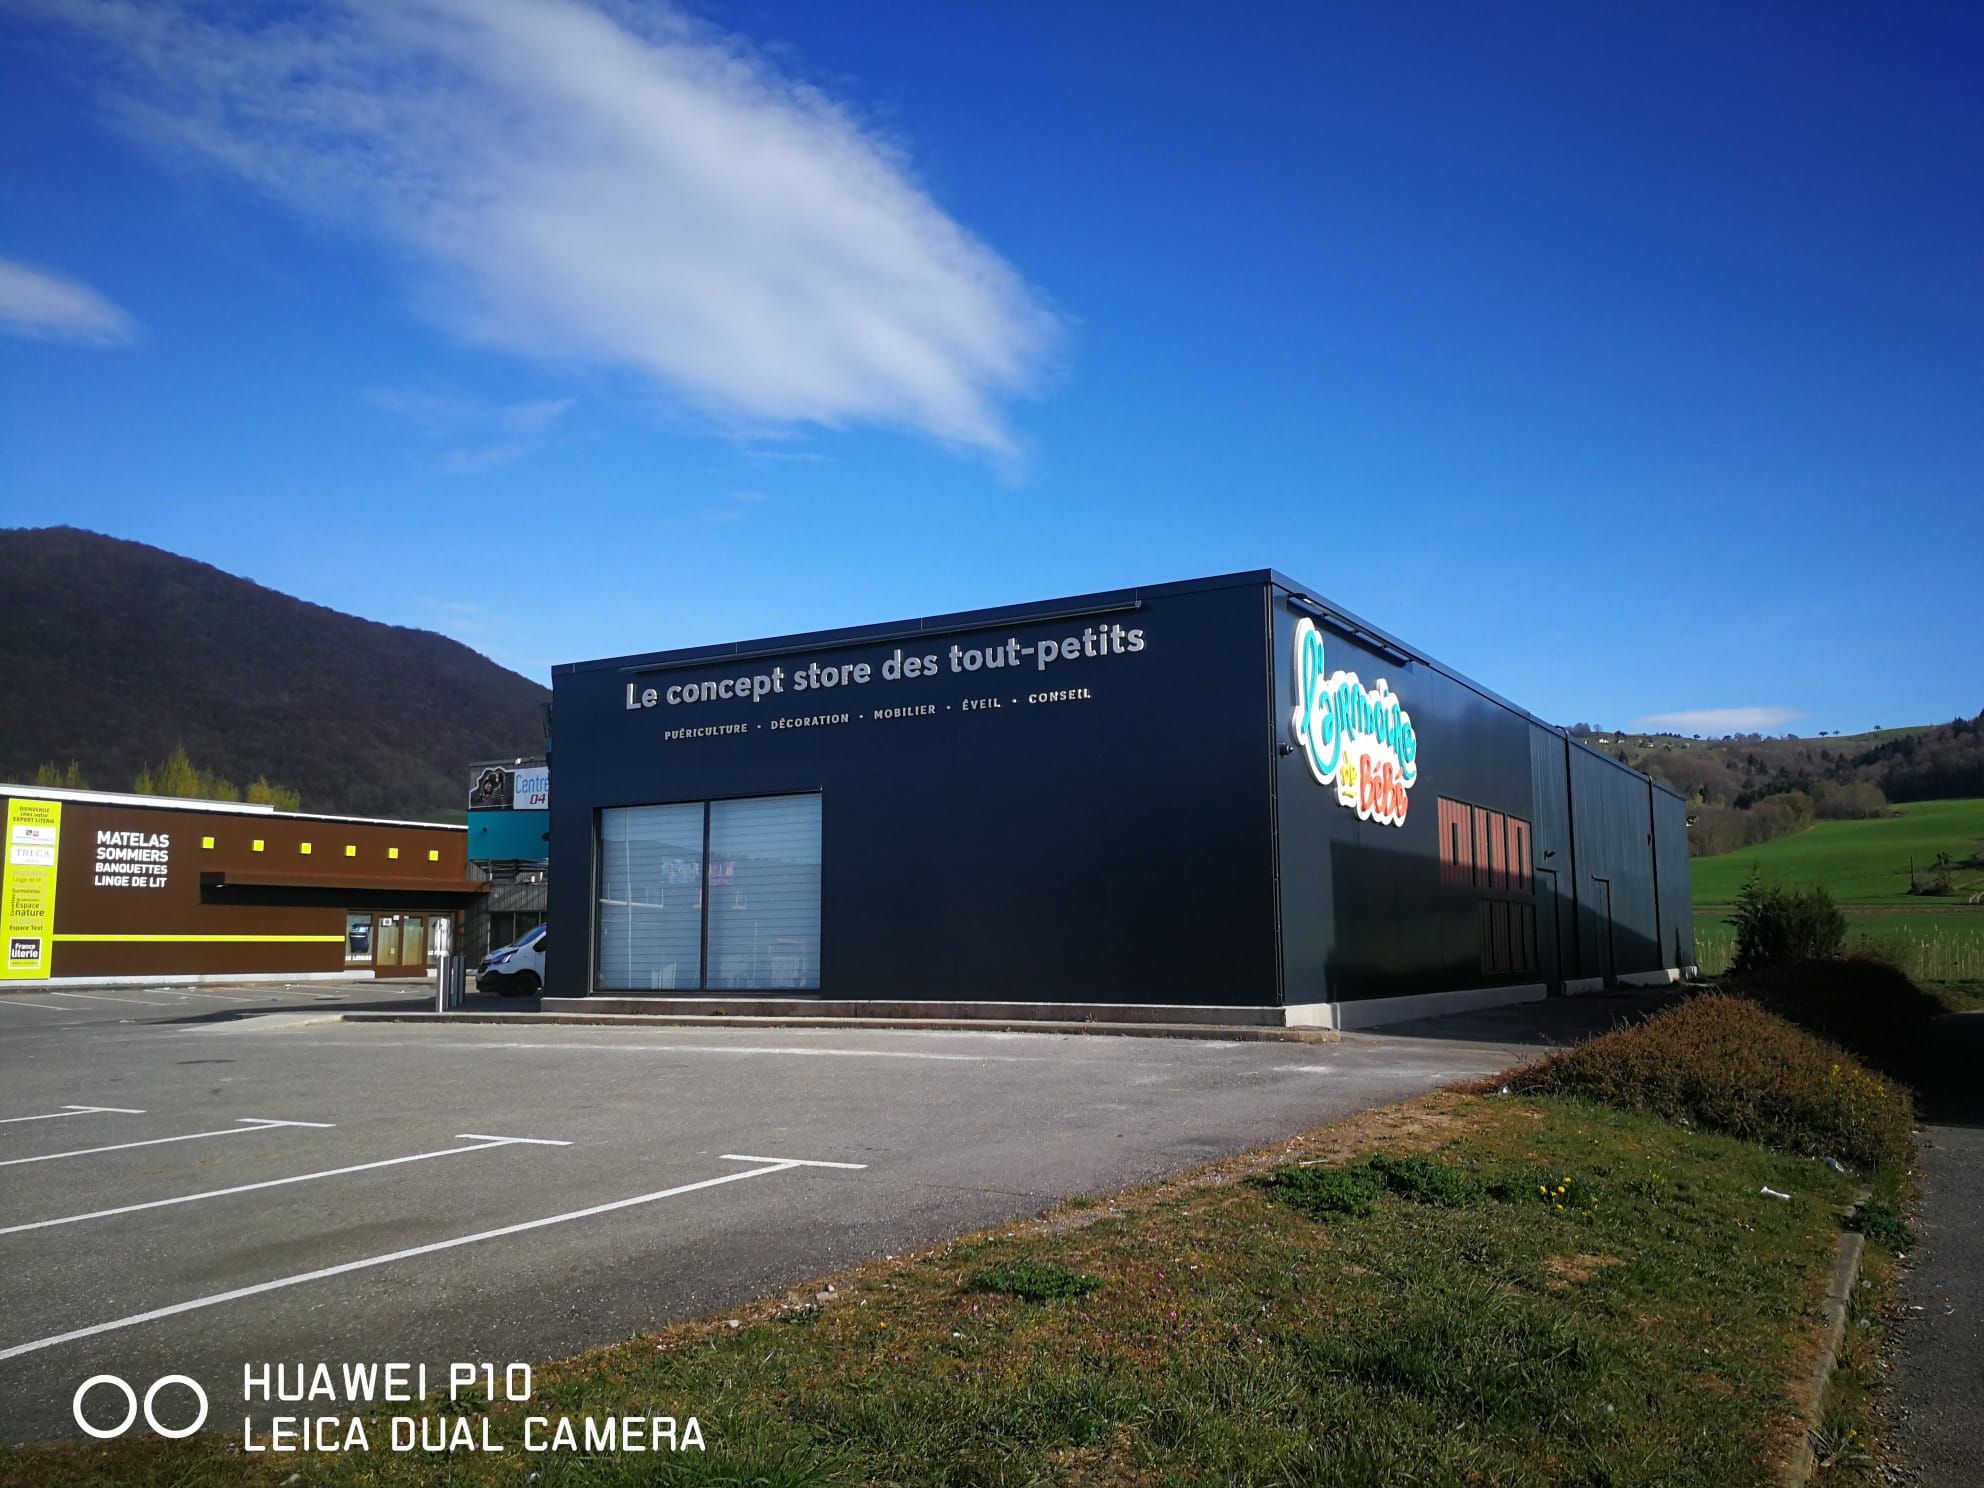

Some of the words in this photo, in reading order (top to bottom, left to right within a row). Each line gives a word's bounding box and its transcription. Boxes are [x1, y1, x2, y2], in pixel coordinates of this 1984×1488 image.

[625, 682, 658, 710] Le
[666, 667, 785, 702] concept
[793, 662, 871, 691] store
[881, 649, 938, 681] des
[949, 623, 1145, 673] tout-petits
[664, 723, 748, 740] PUÉRICULTURE
[770, 713, 849, 730] DÉCORATION
[874, 704, 936, 720] MOBILIER
[962, 698, 1001, 711] ÉVEIL
[1028, 688, 1091, 704] CONSEIL
[515, 774, 549, 794] Centre
[529, 793, 546, 805] 04
[97, 830, 170, 848] MATELAS
[96, 846, 169, 862] SOMMIERS
[95, 862, 168, 875] BANQUETTES
[94, 875, 129, 887] LINGE
[131, 876, 148, 887] DE
[149, 877, 167, 888] LIT
[15, 902, 40, 910] Espace
[15, 908, 45, 917] nature
